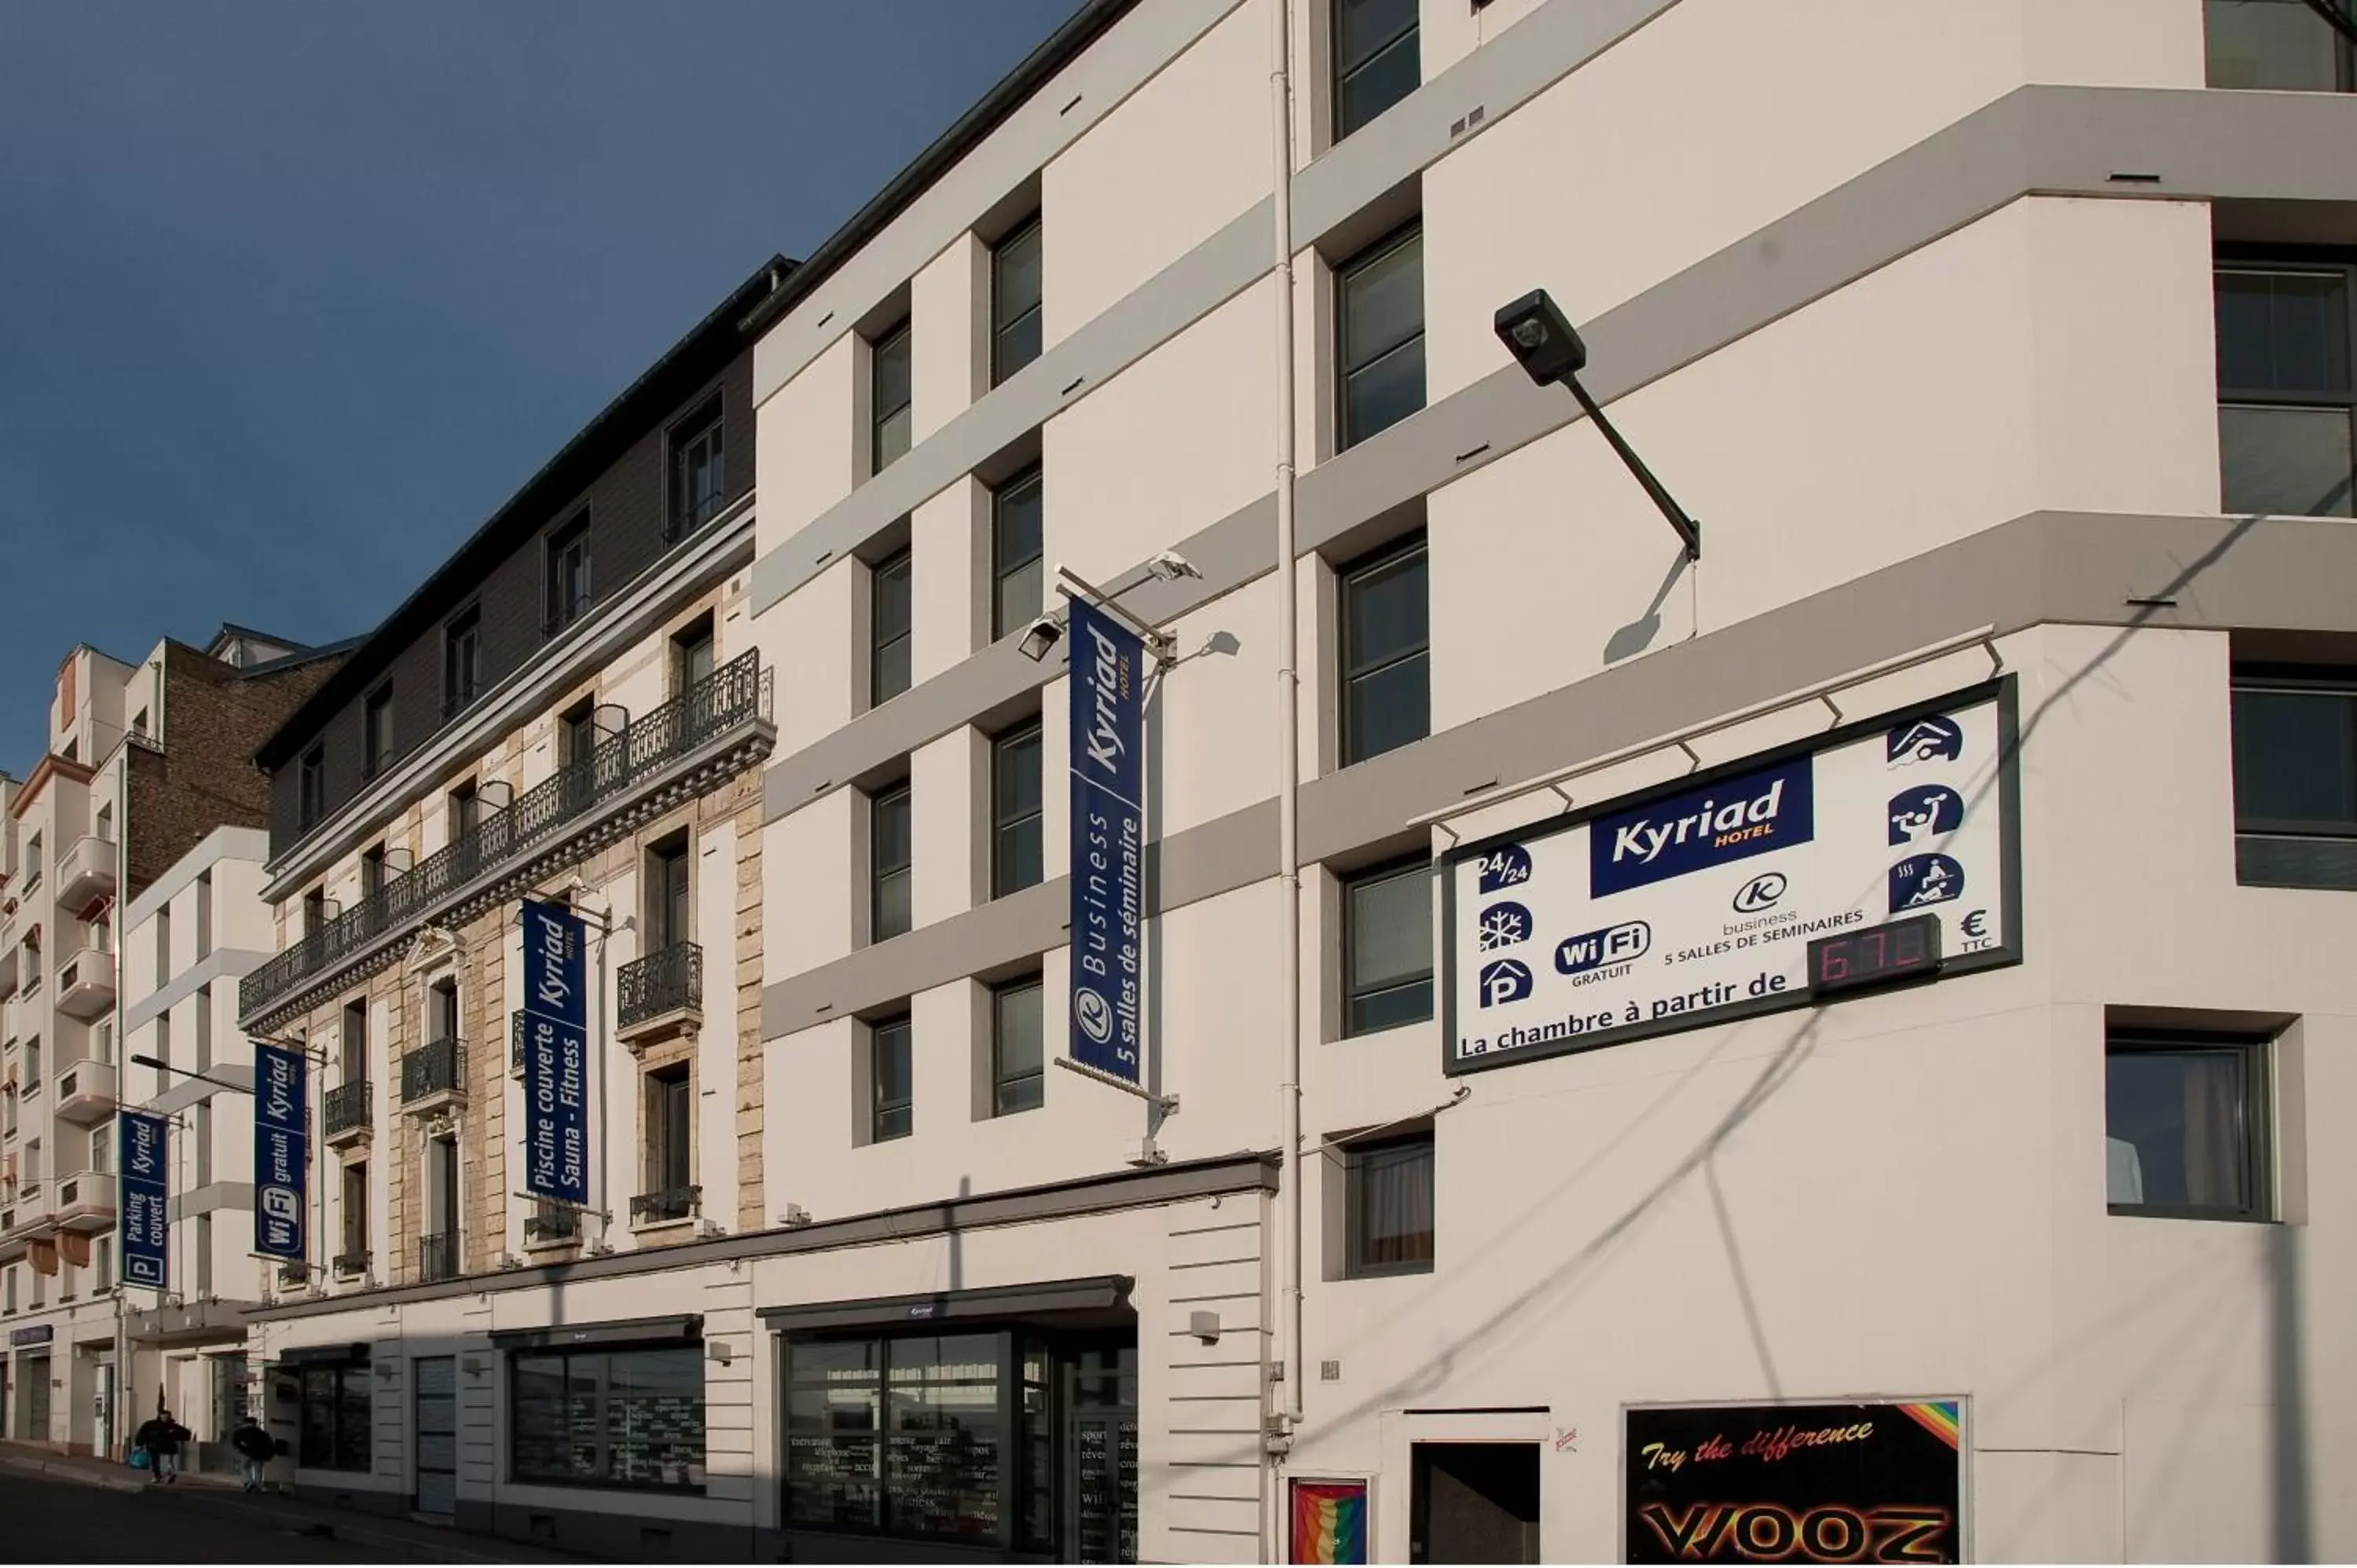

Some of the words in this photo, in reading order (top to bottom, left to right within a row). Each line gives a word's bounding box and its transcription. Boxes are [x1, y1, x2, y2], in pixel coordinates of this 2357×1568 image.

[1087, 621, 1125, 775] Kyriad
[1120, 654, 1129, 701] HOTEL
[1612, 779, 1785, 864] Kyriad
[1714, 822, 1774, 848] HOTEL
[1116, 817, 1137, 940] séminaire
[1479, 850, 1527, 883] 24/24
[1083, 813, 1107, 976] Business
[1665, 953, 1673, 965] 5
[1678, 940, 1731, 962] SALLES
[1737, 934, 1757, 950] DE
[1763, 910, 1863, 943] SEMINAIRES
[1723, 910, 1798, 936] business
[1961, 909, 1987, 936] €
[1962, 937, 1992, 953] TTC
[537, 914, 570, 1009] Kyriad
[1116, 944, 1136, 973] de
[1572, 963, 1633, 987] GRATUIT
[1116, 979, 1135, 1046] salles
[1462, 1037, 1486, 1057] La
[1497, 1011, 1613, 1047] chambre
[1625, 1001, 1640, 1022] à
[1652, 982, 1736, 1020] partir
[1749, 972, 1787, 1012] de
[538, 1023, 554, 1113] couverte
[560, 1038, 579, 1108] Fitness
[1116, 1046, 1135, 1064] 5
[266, 1053, 293, 1122] Kyriad
[131, 1119, 155, 1174] Kyriad
[272, 1133, 291, 1182] gratuit
[534, 1118, 554, 1188] Piscine
[561, 1130, 581, 1188] Sauna
[126, 1192, 147, 1243] Parking
[149, 1196, 163, 1247] couvert
[1641, 1442, 1688, 1473] Try
[1694, 1434, 1734, 1463] the
[1741, 1421, 1874, 1463] difference
[1640, 1504, 1948, 1564] WOOZ
